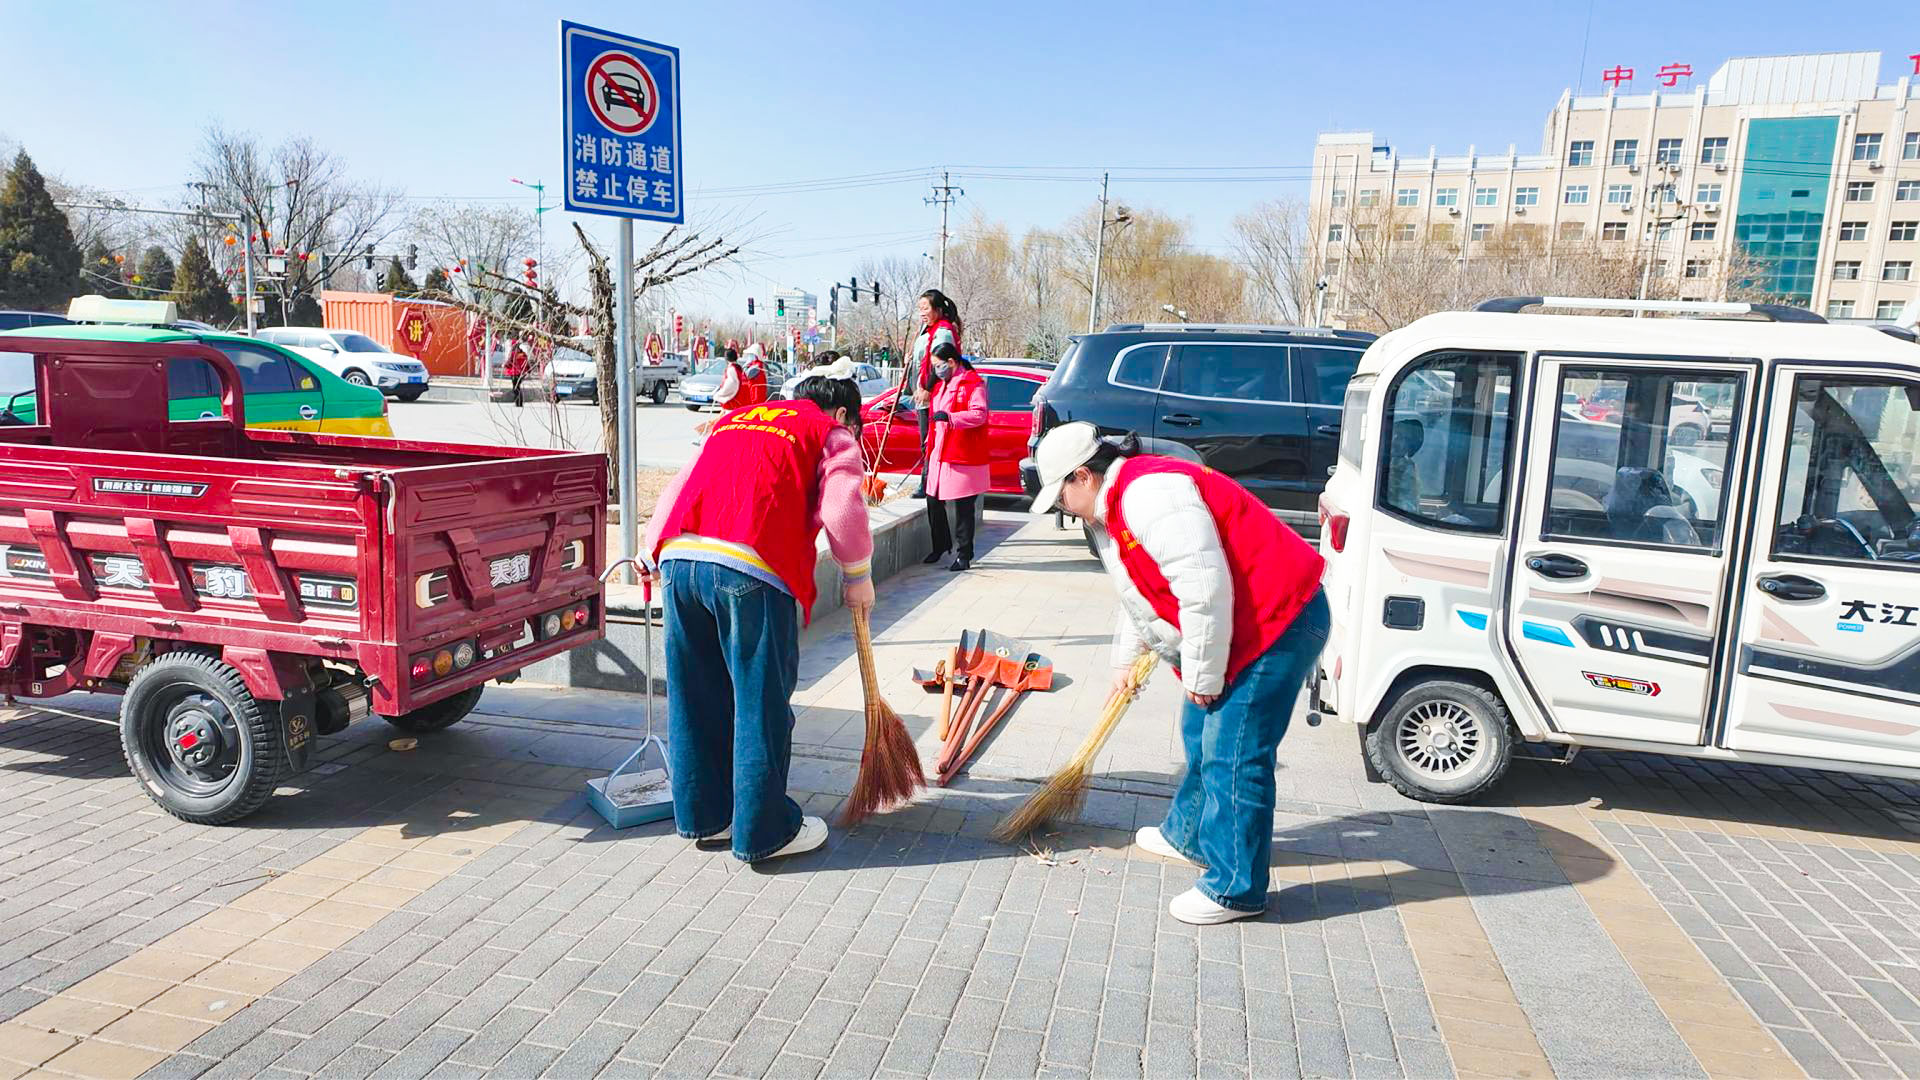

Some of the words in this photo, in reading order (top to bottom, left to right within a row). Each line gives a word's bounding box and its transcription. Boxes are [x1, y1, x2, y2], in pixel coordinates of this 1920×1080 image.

[1602, 62, 1693, 88] 中宁
[574, 133, 672, 174] 消防通道
[575, 168, 673, 208] 禁止停车
[408, 319, 424, 342] 讲
[105, 556, 144, 588] 天
[205, 566, 245, 598] 豹
[490, 553, 531, 588] 天豹
[1838, 600, 1919, 627] 大江
